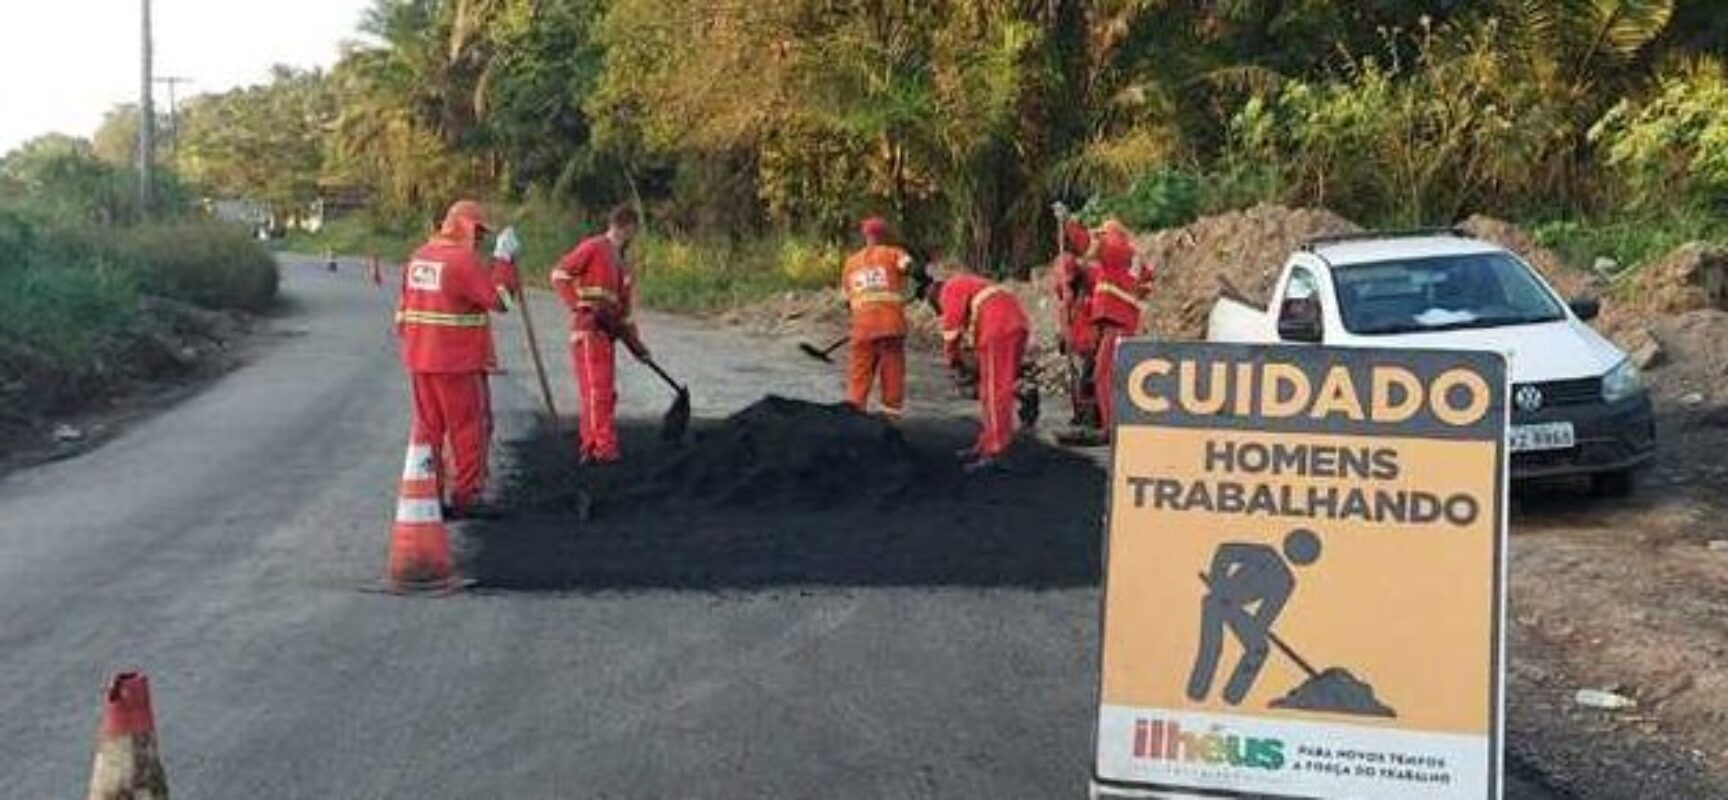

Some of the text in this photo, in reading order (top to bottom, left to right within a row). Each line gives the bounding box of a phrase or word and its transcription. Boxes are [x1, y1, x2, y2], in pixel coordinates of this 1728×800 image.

[1127, 357, 1490, 426] CUIDADO
[1204, 441, 1399, 478] HOMENS
[1128, 477, 1479, 527] TRABALHANDO
[1133, 718, 1285, 770] ilhéus
[1299, 745, 1332, 757] PARA
[1355, 765, 1375, 776] DO
